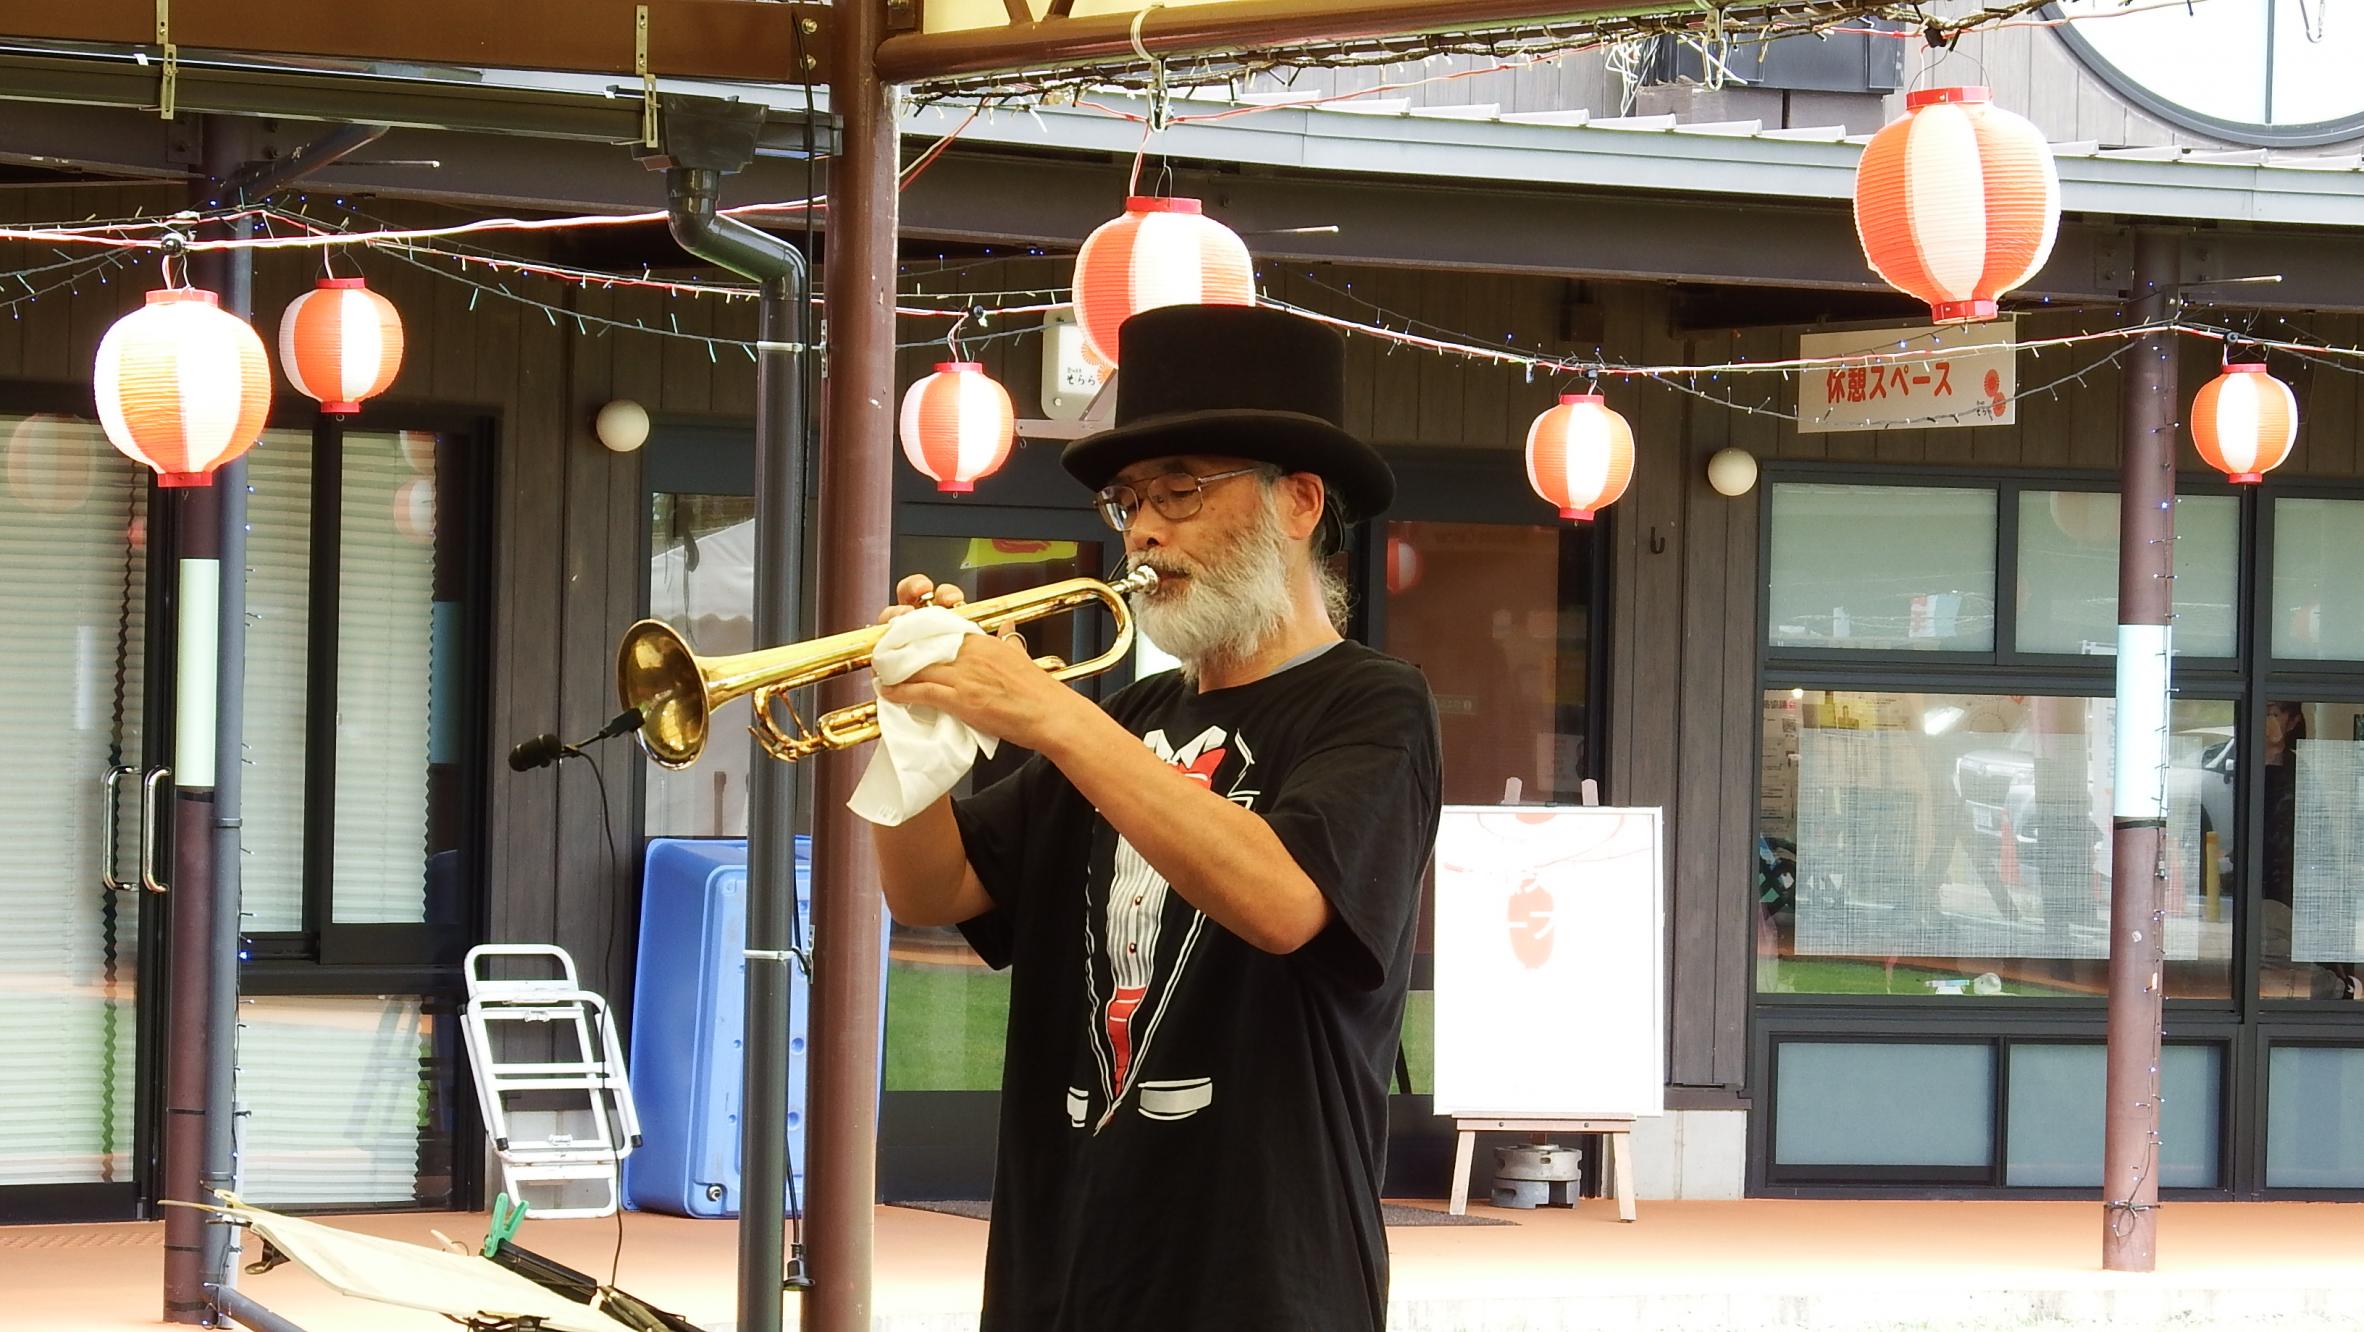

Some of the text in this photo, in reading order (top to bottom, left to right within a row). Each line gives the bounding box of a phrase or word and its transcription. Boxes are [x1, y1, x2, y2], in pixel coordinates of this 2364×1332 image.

[1827, 362, 1952, 404] 休憩スペース
